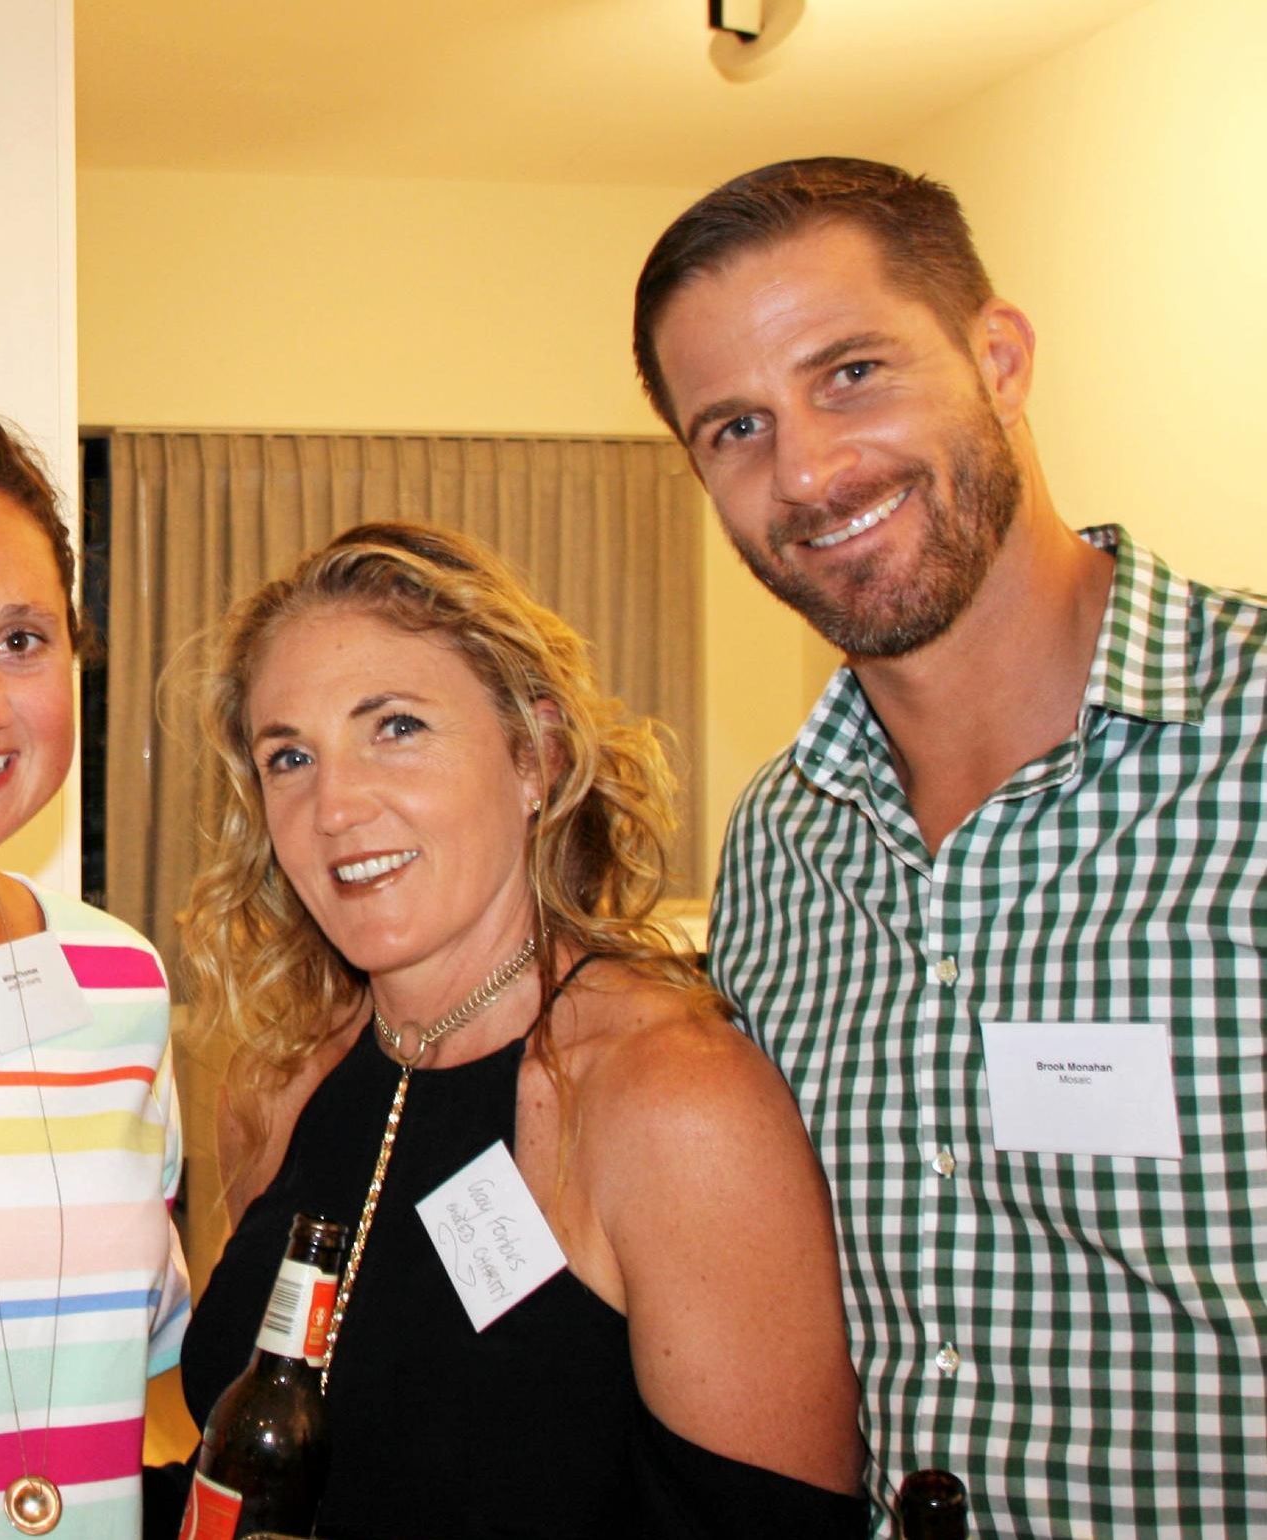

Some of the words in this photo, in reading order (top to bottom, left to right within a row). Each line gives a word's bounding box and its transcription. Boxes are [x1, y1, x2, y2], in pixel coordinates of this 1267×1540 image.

[1036, 1061, 1065, 1072] Brook
[1067, 1063, 1113, 1073] Monahan
[1059, 1075, 1093, 1086] Mosaic
